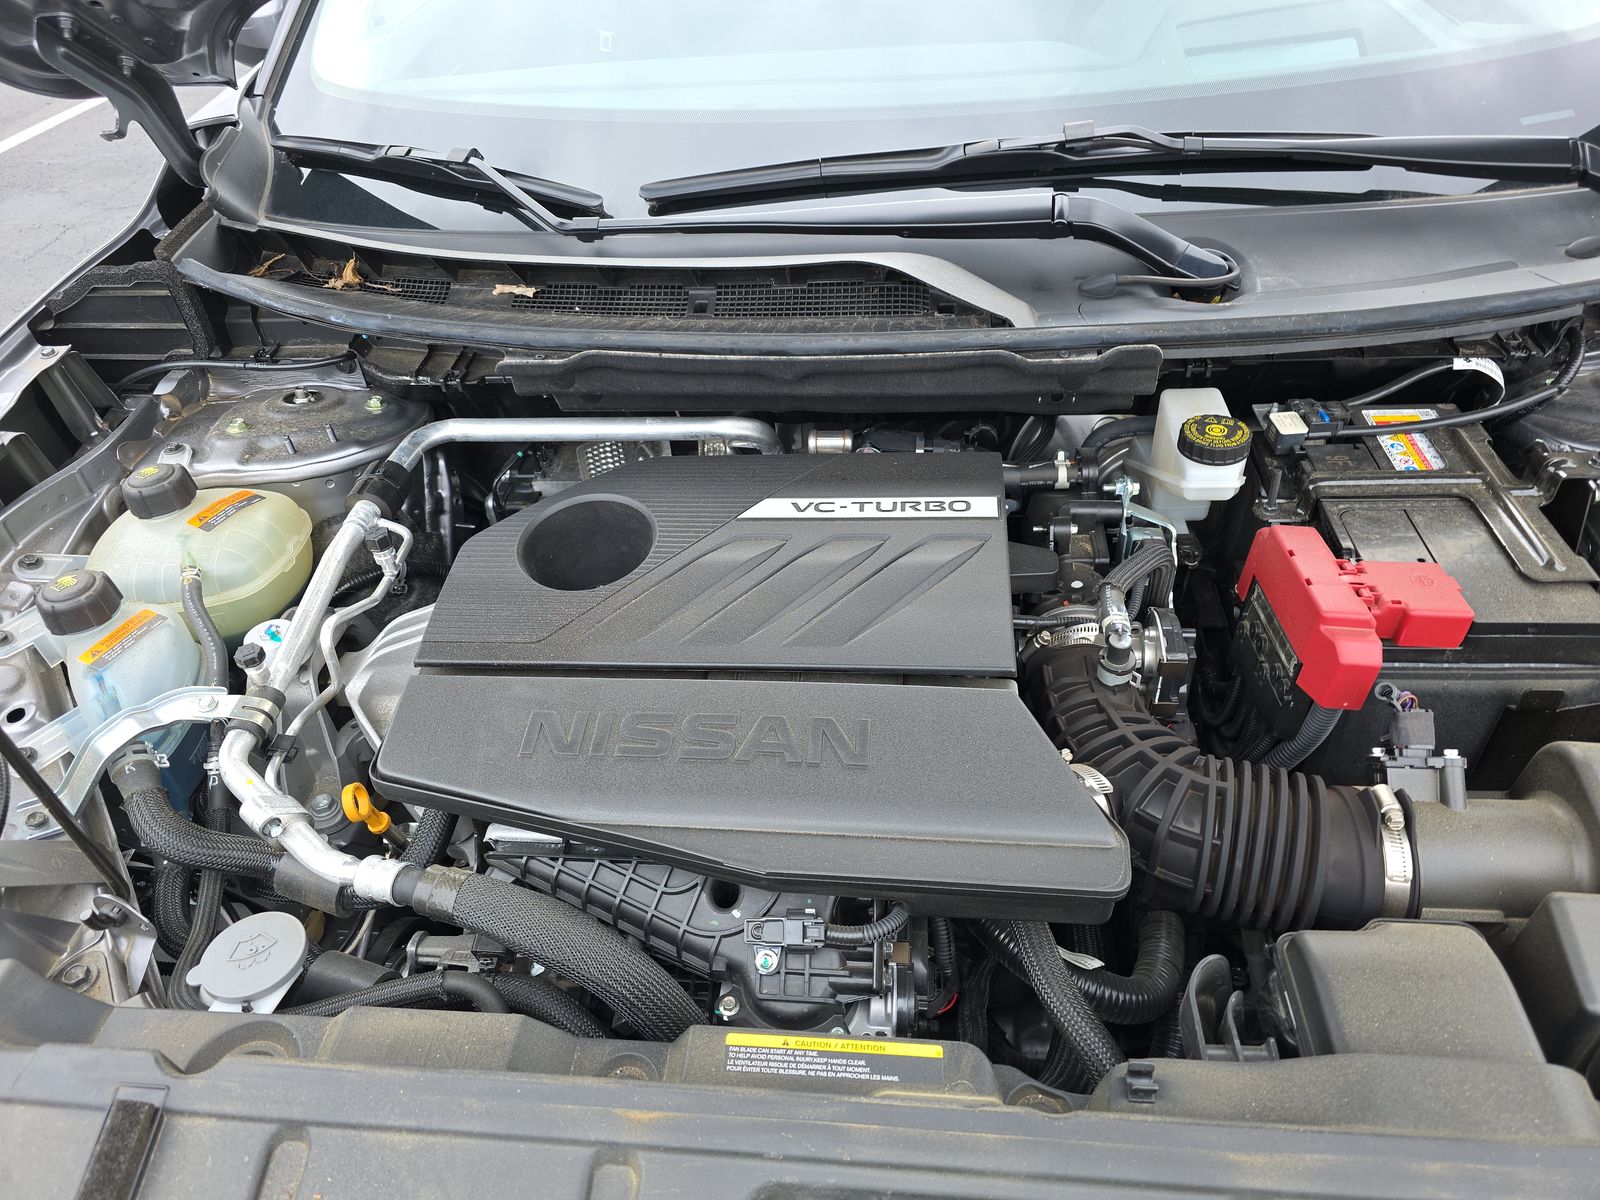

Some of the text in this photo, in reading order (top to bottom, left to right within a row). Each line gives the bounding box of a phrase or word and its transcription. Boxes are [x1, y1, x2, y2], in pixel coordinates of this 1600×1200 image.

[791, 500, 971, 513] VC-TURBO
[518, 709, 870, 767] NISSAN
[794, 1040, 832, 1049] CAUTION
[840, 1042, 886, 1052] ATTENTION
[742, 1065, 760, 1073] ÉVITER
[797, 1062, 826, 1070] DÉMARRER
